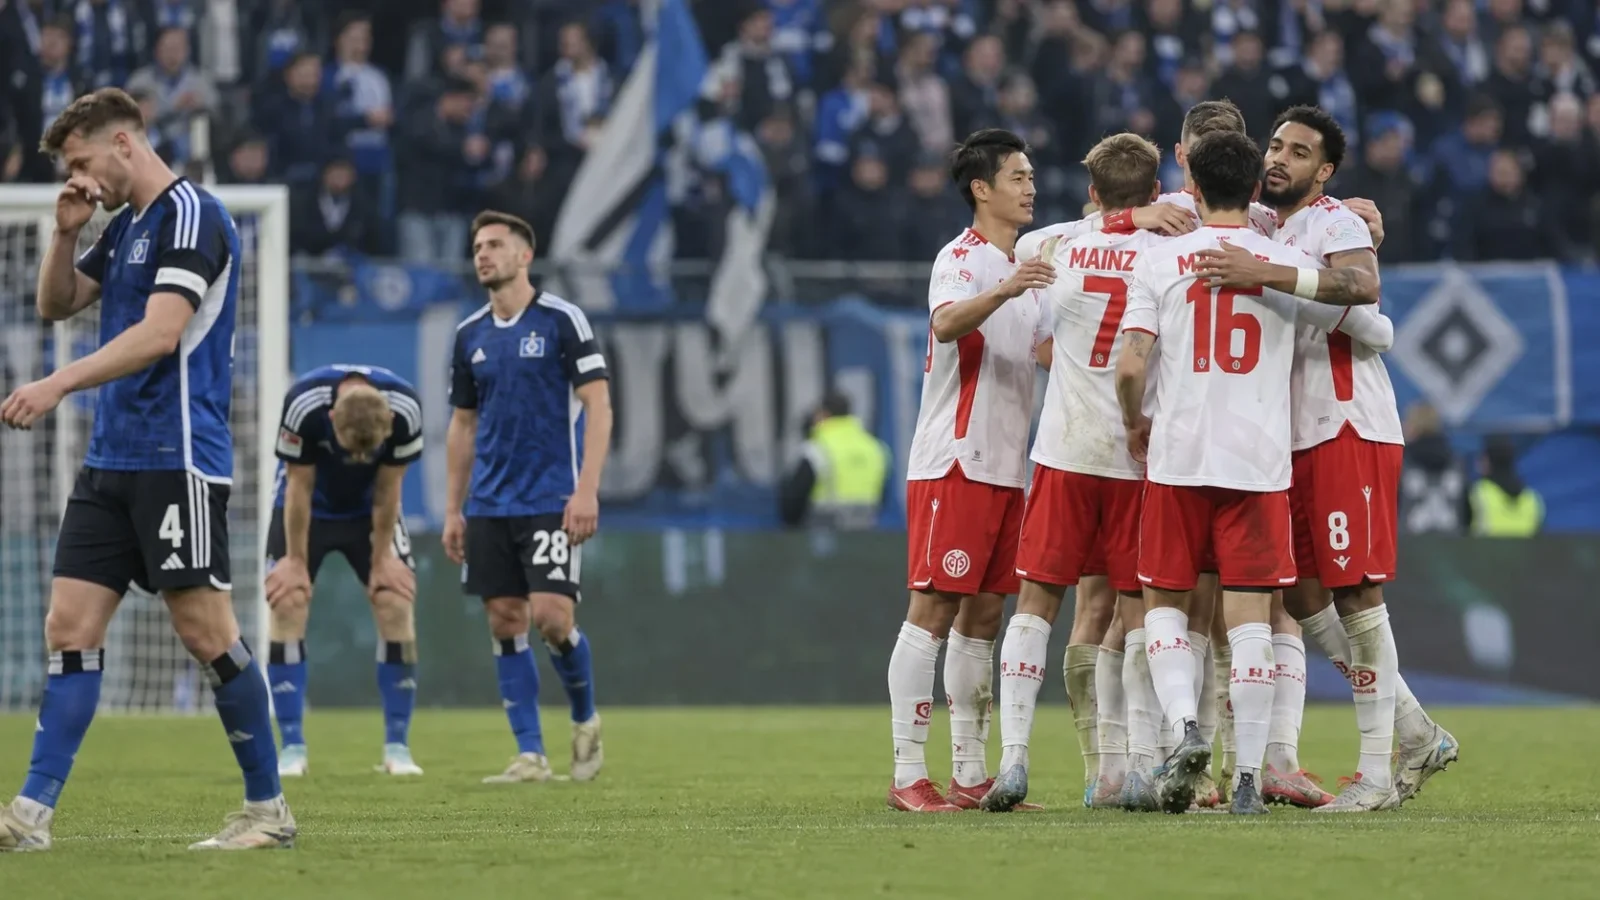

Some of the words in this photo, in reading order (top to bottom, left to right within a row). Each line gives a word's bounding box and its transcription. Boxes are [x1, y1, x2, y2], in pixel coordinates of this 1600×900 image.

[1069, 248, 1137, 272] MAINZ
[1083, 275, 1128, 368] 7
[1186, 277, 1264, 375] 16
[159, 504, 185, 548] 4
[1328, 511, 1350, 551] 8
[532, 529, 569, 566] 28
